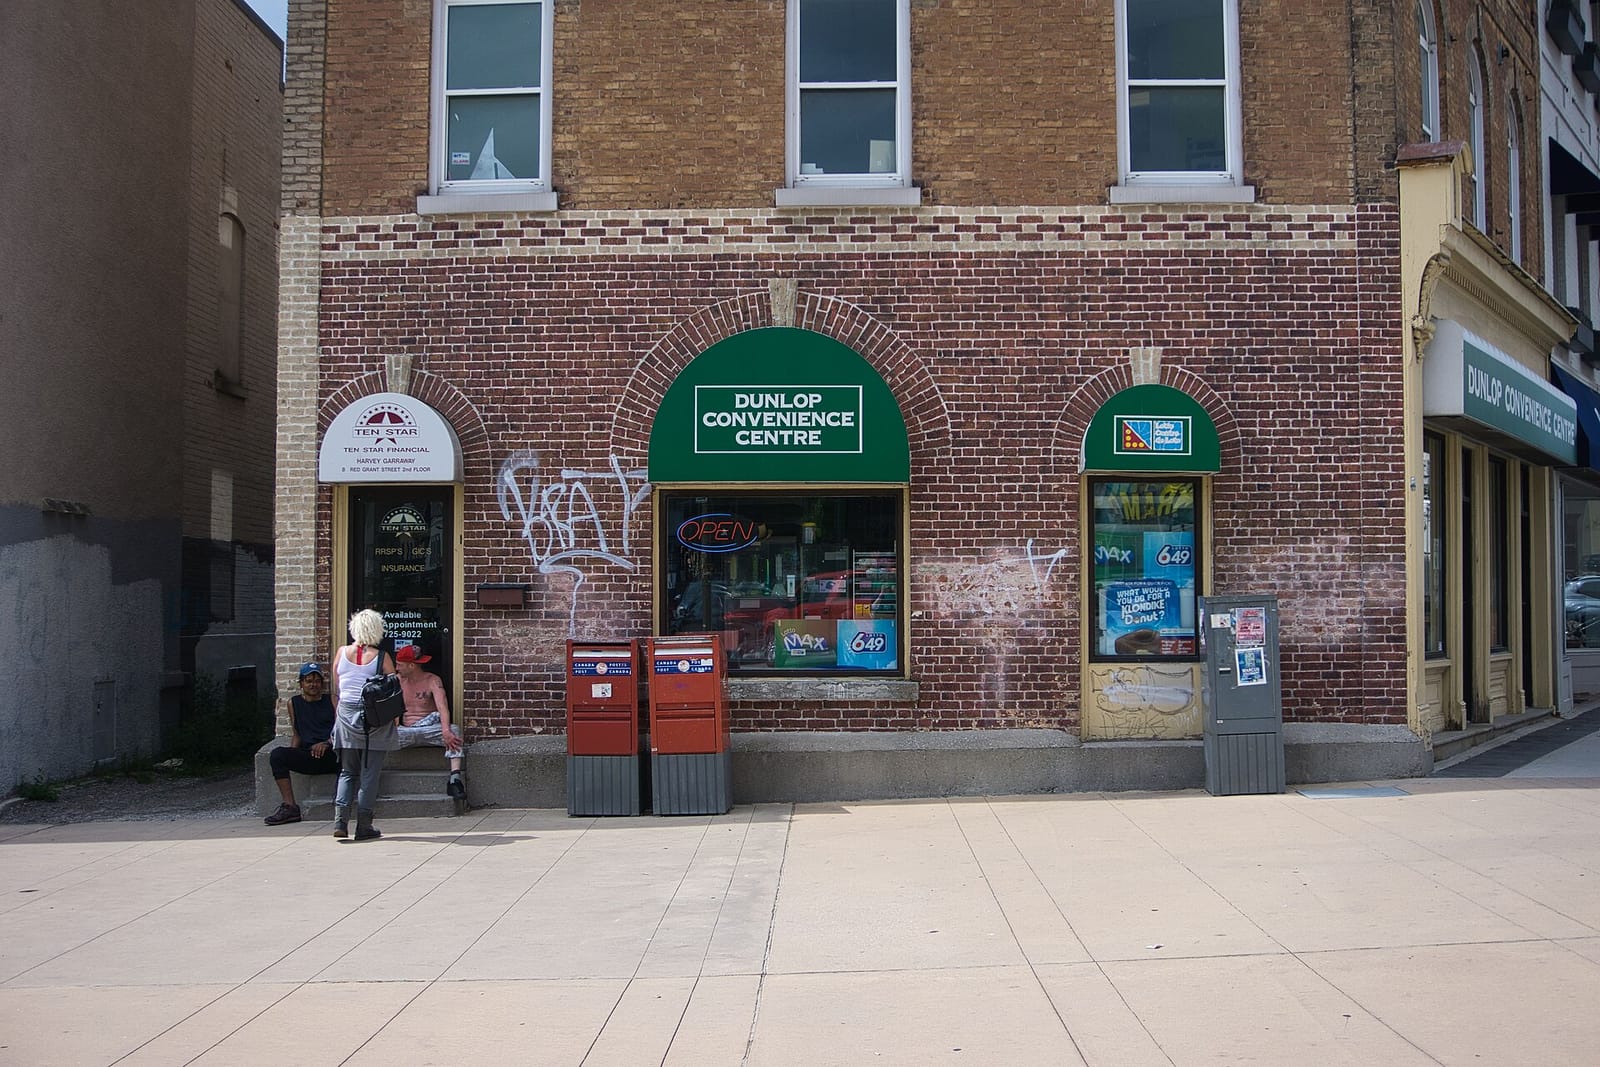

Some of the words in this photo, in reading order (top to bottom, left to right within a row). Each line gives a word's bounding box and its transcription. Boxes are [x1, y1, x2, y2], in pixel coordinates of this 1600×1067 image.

[734, 393, 822, 409] DUNLOP
[1468, 364, 1502, 407] DUNLOP
[1504, 385, 1552, 433] CONVENIENCE
[1553, 412, 1575, 446] CENTRE
[702, 411, 855, 427] CONVENIENCE
[354, 428, 380, 436] TEN
[385, 428, 418, 436] STAR
[735, 430, 822, 445] CENTRE
[679, 521, 755, 541] OPEN
[381, 564, 425, 572] INSURANCE
[1116, 588, 1140, 598] WHAT
[1142, 587, 1169, 595] WOULD
[1116, 597, 1132, 606] YOU
[1134, 595, 1145, 603] DO
[1147, 592, 1162, 601] FOR
[1164, 591, 1171, 599] A
[384, 611, 422, 619] Available
[1121, 599, 1165, 619] KLONDIKE
[383, 620, 437, 630] Appointment
[384, 630, 422, 638] 725-9022
[783, 633, 825, 652] MAX
